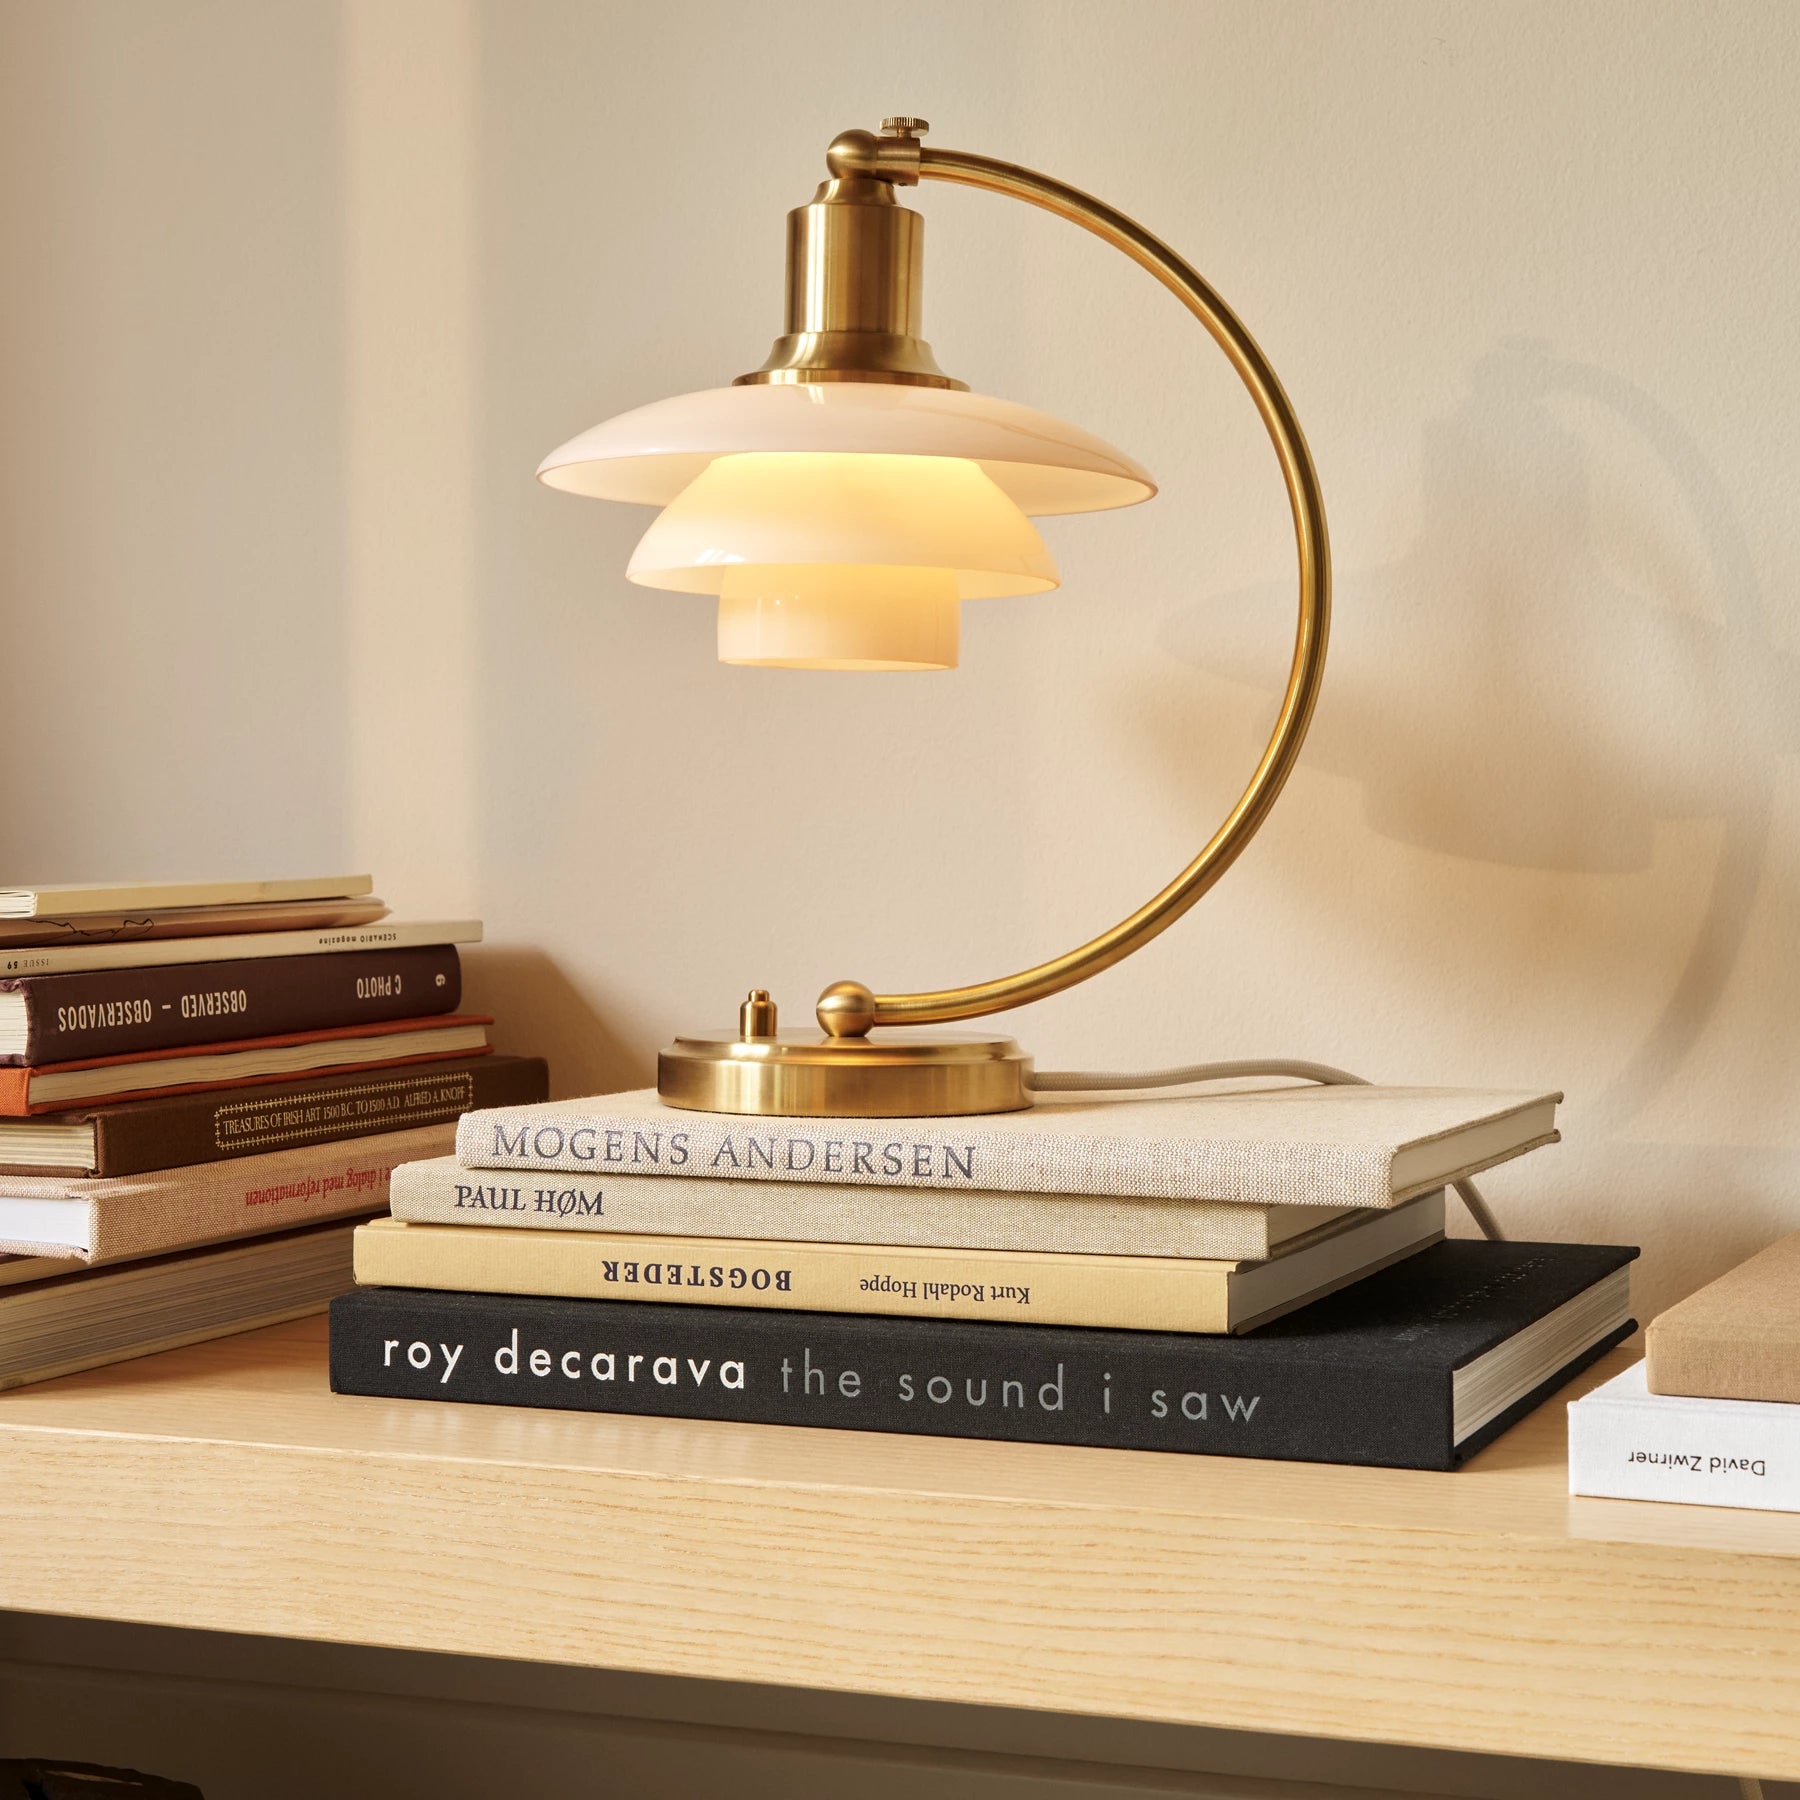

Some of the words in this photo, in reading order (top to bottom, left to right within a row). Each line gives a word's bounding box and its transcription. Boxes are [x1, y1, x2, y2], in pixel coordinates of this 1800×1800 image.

[7, 960, 18, 970] 59
[23, 958, 49, 968] ISSUE
[356, 975, 391, 999] PHOTO
[395, 974, 401, 995] C
[58, 999, 151, 1032] OBSERVADOS
[181, 989, 247, 1018] OBSERVED
[404, 1092, 432, 1107] ALFRED
[440, 1086, 465, 1102] KNOPF
[223, 1115, 270, 1135] TREASURES
[270, 1112, 283, 1128] OF
[283, 1109, 304, 1126] IRISH
[305, 1106, 321, 1122] ART
[323, 1104, 340, 1120] 1500
[356, 1099, 368, 1115] TO
[369, 1097, 385, 1112] 1500
[491, 1125, 690, 1165] MOGENS
[713, 1134, 977, 1180] ANDERSEN
[245, 1176, 321, 1206] reformationen
[323, 1174, 344, 1199] med
[346, 1167, 376, 1192] dialog
[454, 1185, 526, 1211] PAUL
[534, 1190, 604, 1218] HØM
[601, 1260, 792, 1292] BOGSTEDER
[859, 1276, 918, 1299] Hoppe
[922, 1279, 986, 1303] Rodahl
[990, 1284, 1031, 1305] Kurt
[383, 1339, 464, 1384] roy
[494, 1328, 745, 1389] decarava
[780, 1348, 861, 1398] the
[899, 1363, 1064, 1412] sound
[1103, 1373, 1111, 1414] i
[1150, 1388, 1260, 1423] saw
[1628, 1451, 1702, 1472] Zwirner
[1710, 1456, 1766, 1477] David
